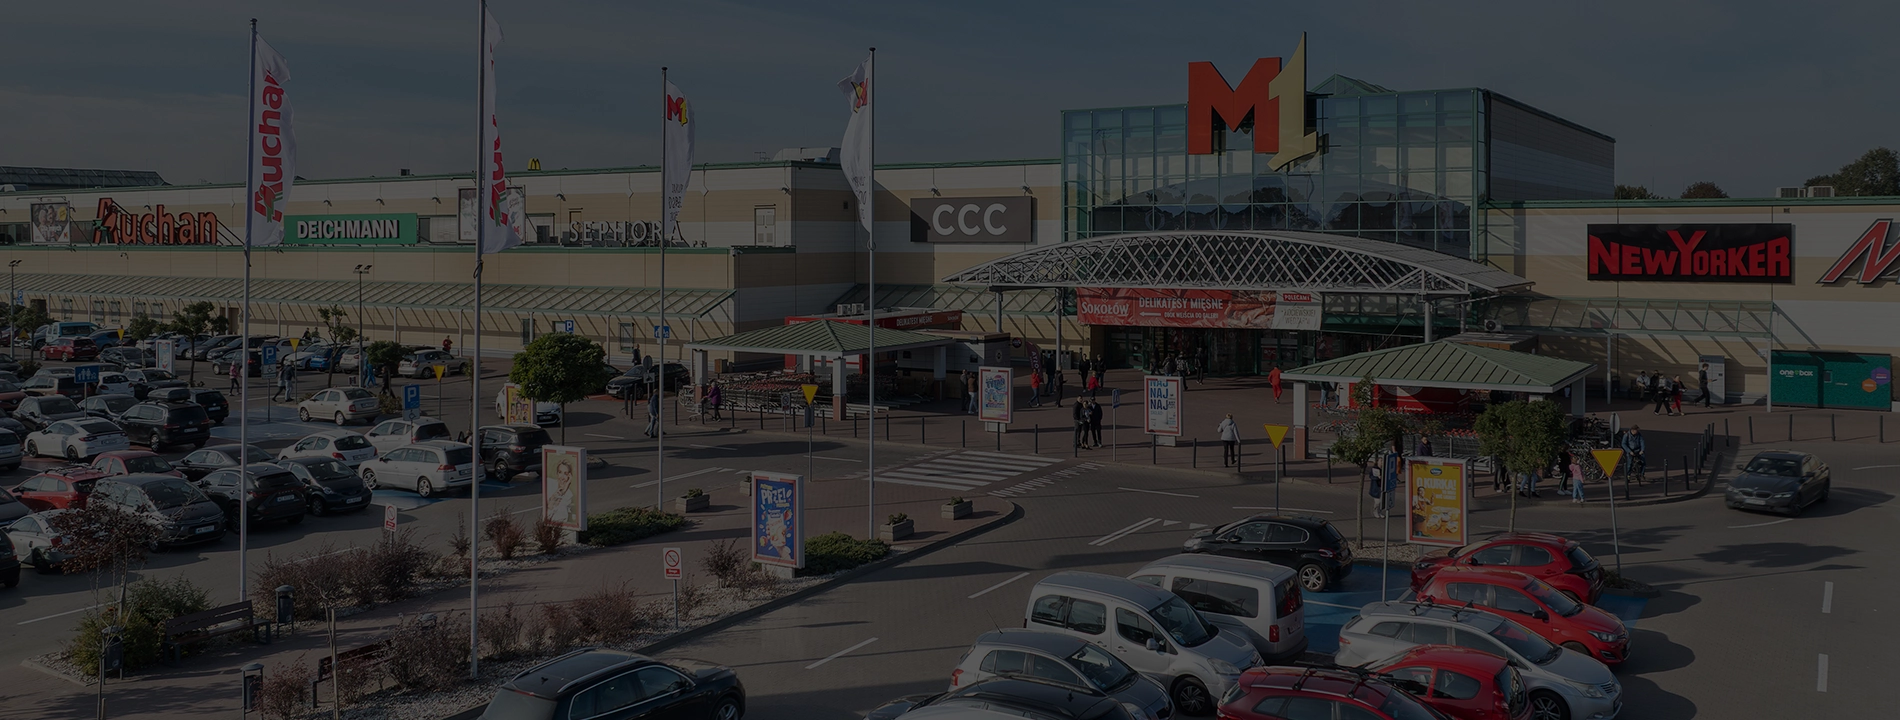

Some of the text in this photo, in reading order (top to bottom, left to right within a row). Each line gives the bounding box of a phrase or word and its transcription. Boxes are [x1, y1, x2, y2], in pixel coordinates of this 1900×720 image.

[1188, 31, 1317, 172] M1
[667, 94, 689, 127] M1
[93, 197, 219, 245] Auchan
[932, 203, 1007, 236] CCC
[297, 219, 400, 240] DEICHMANN
[569, 220, 684, 243] SEPHORA
[1081, 302, 1129, 316] SOKOŁÓW
[1139, 297, 1223, 311] DELIKATESY MIĘSNE
[566, 321, 572, 330] P
[897, 315, 933, 327] DELIKATESY MIĘSNE
[266, 347, 274, 359] P
[407, 386, 417, 402] P
[1150, 387, 1168, 399] NAJ
[1150, 399, 1169, 410] NAJ
[1388, 456, 1395, 480] P
[1416, 477, 1457, 490] O KURKA!
[760, 487, 787, 505] PRZE!
